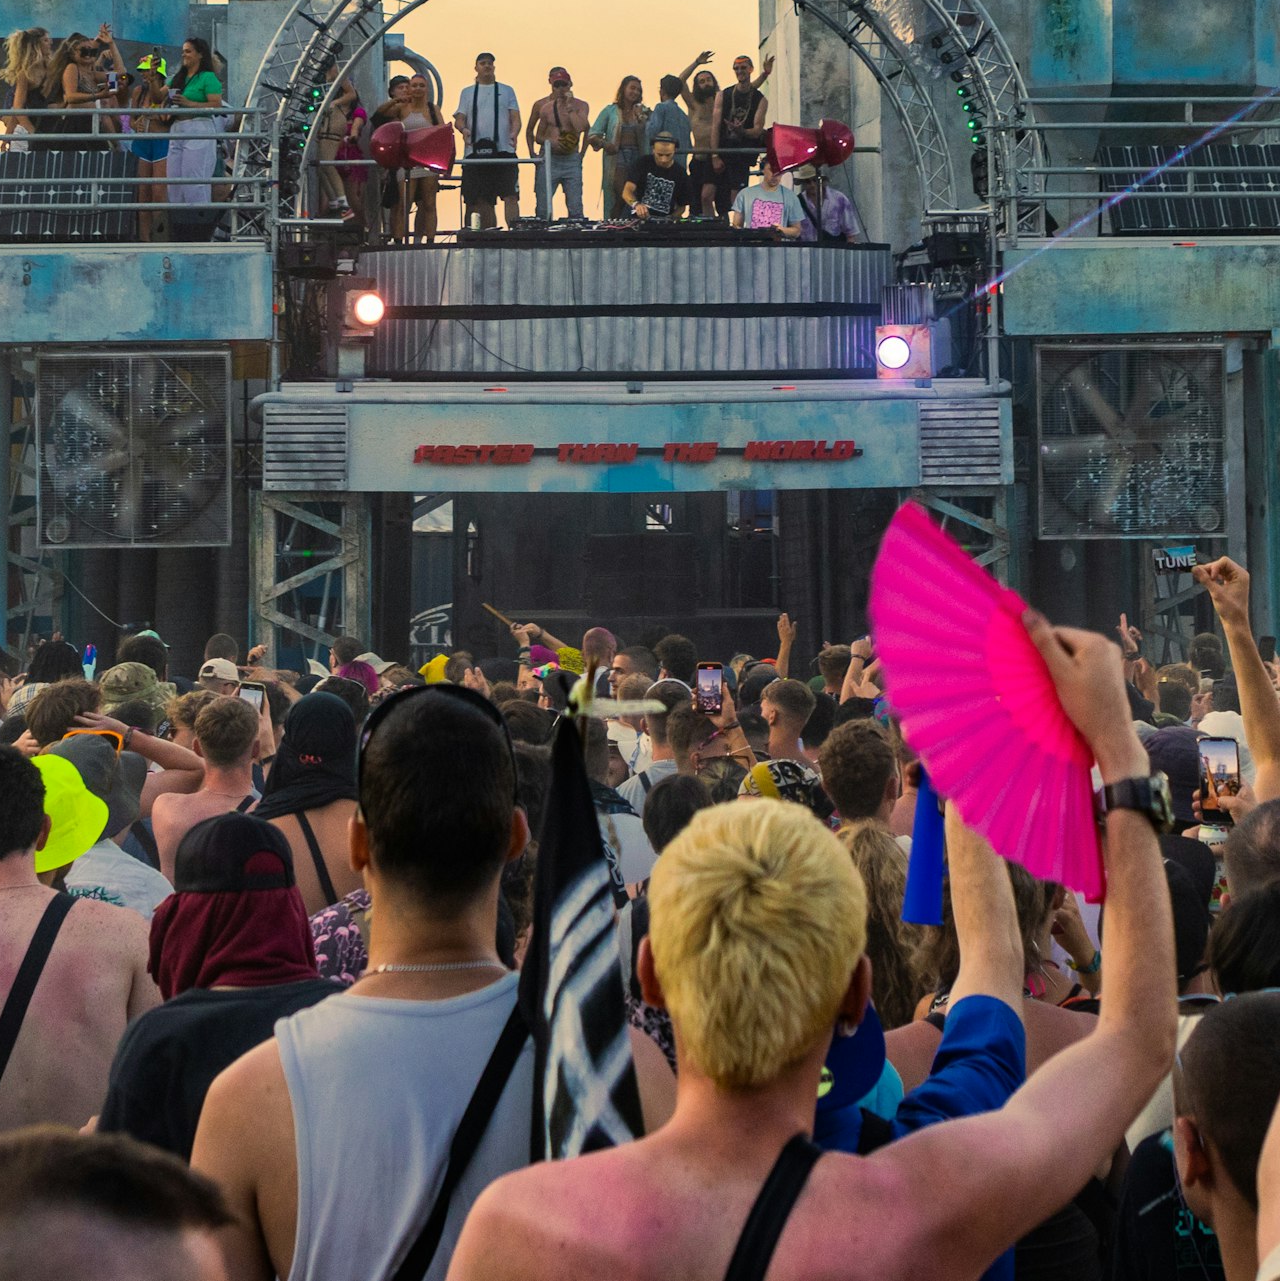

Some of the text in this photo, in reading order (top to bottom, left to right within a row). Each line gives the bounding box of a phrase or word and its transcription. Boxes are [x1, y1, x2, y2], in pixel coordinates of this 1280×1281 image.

[413, 439, 855, 465] FASTER THAN THE WORLD
[1155, 553, 1197, 569] TUNE
